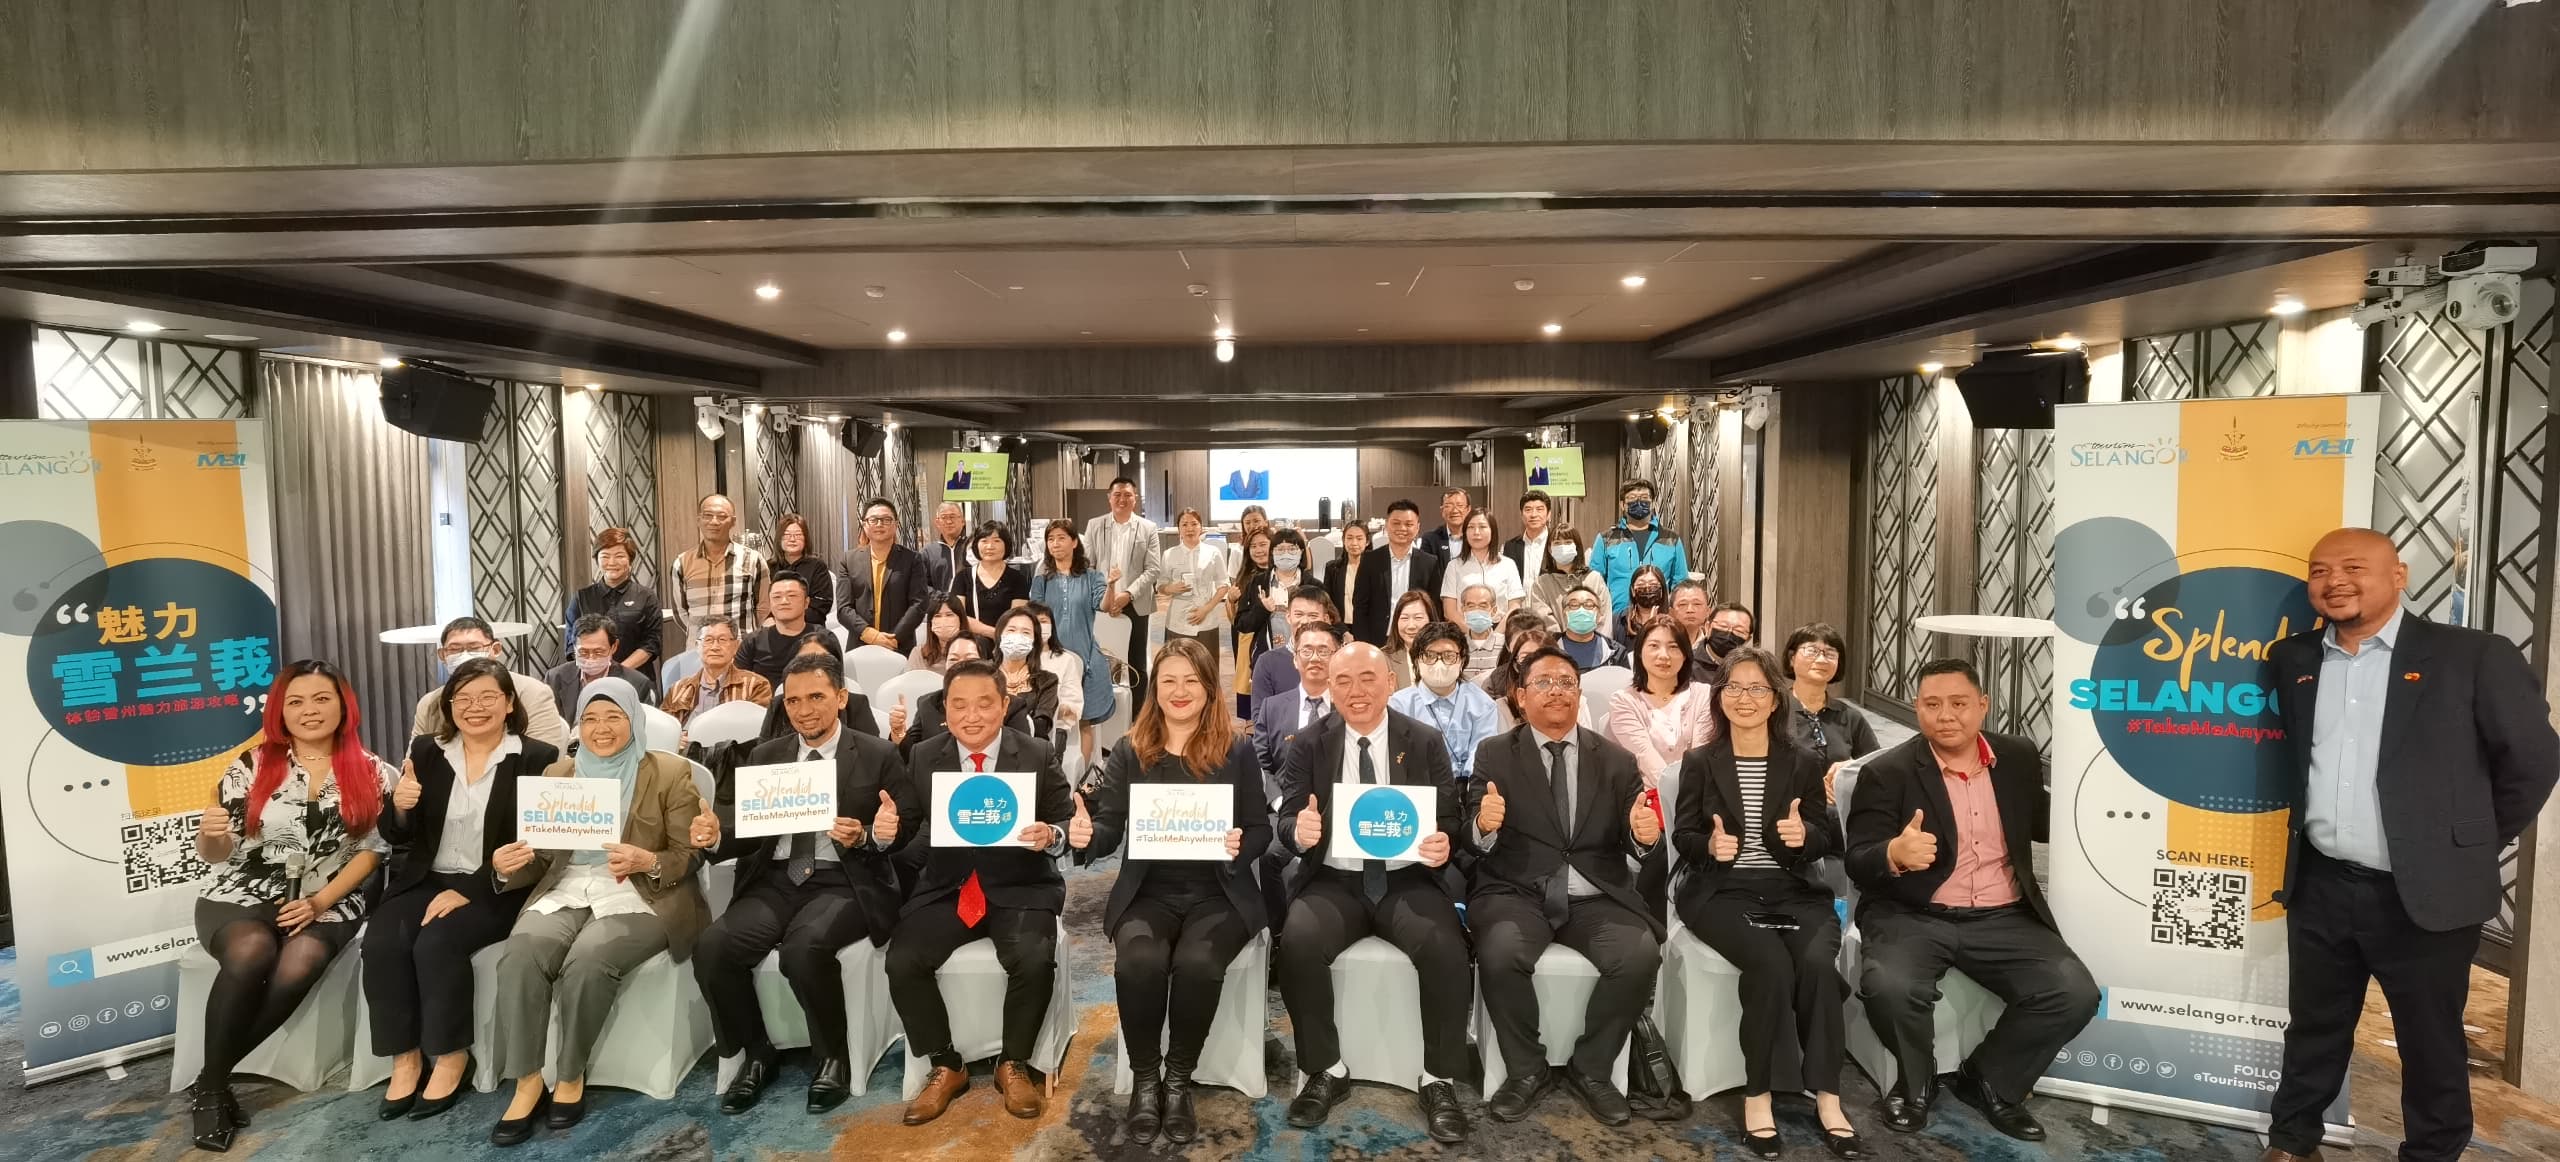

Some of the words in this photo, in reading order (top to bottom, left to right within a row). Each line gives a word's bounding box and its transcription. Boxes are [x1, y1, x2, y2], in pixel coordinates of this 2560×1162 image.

[51, 635, 274, 707] 雪兰莪
[2126, 716, 2288, 745] #TakeMeAnyw
[741, 792, 831, 812] SELANGOR
[753, 776, 812, 809] Splendid
[537, 790, 598, 822] Splendid
[742, 807, 830, 822] #TakeMeAnywhere!
[1150, 798, 1209, 831] Splendid
[523, 810, 614, 825] SELANGOR
[1135, 818, 1227, 832] SELANGOR
[524, 824, 613, 837] #TakeMeAnywhere!
[2156, 849, 2202, 863] SCAN
[2207, 853, 2255, 869] HERE:
[106, 936, 200, 963] www.selan
[2120, 1000, 2289, 1030] www.selangor.trav
[2193, 1071, 2281, 1093] @TourismSel
[2233, 1064, 2283, 1081] FOLLO
